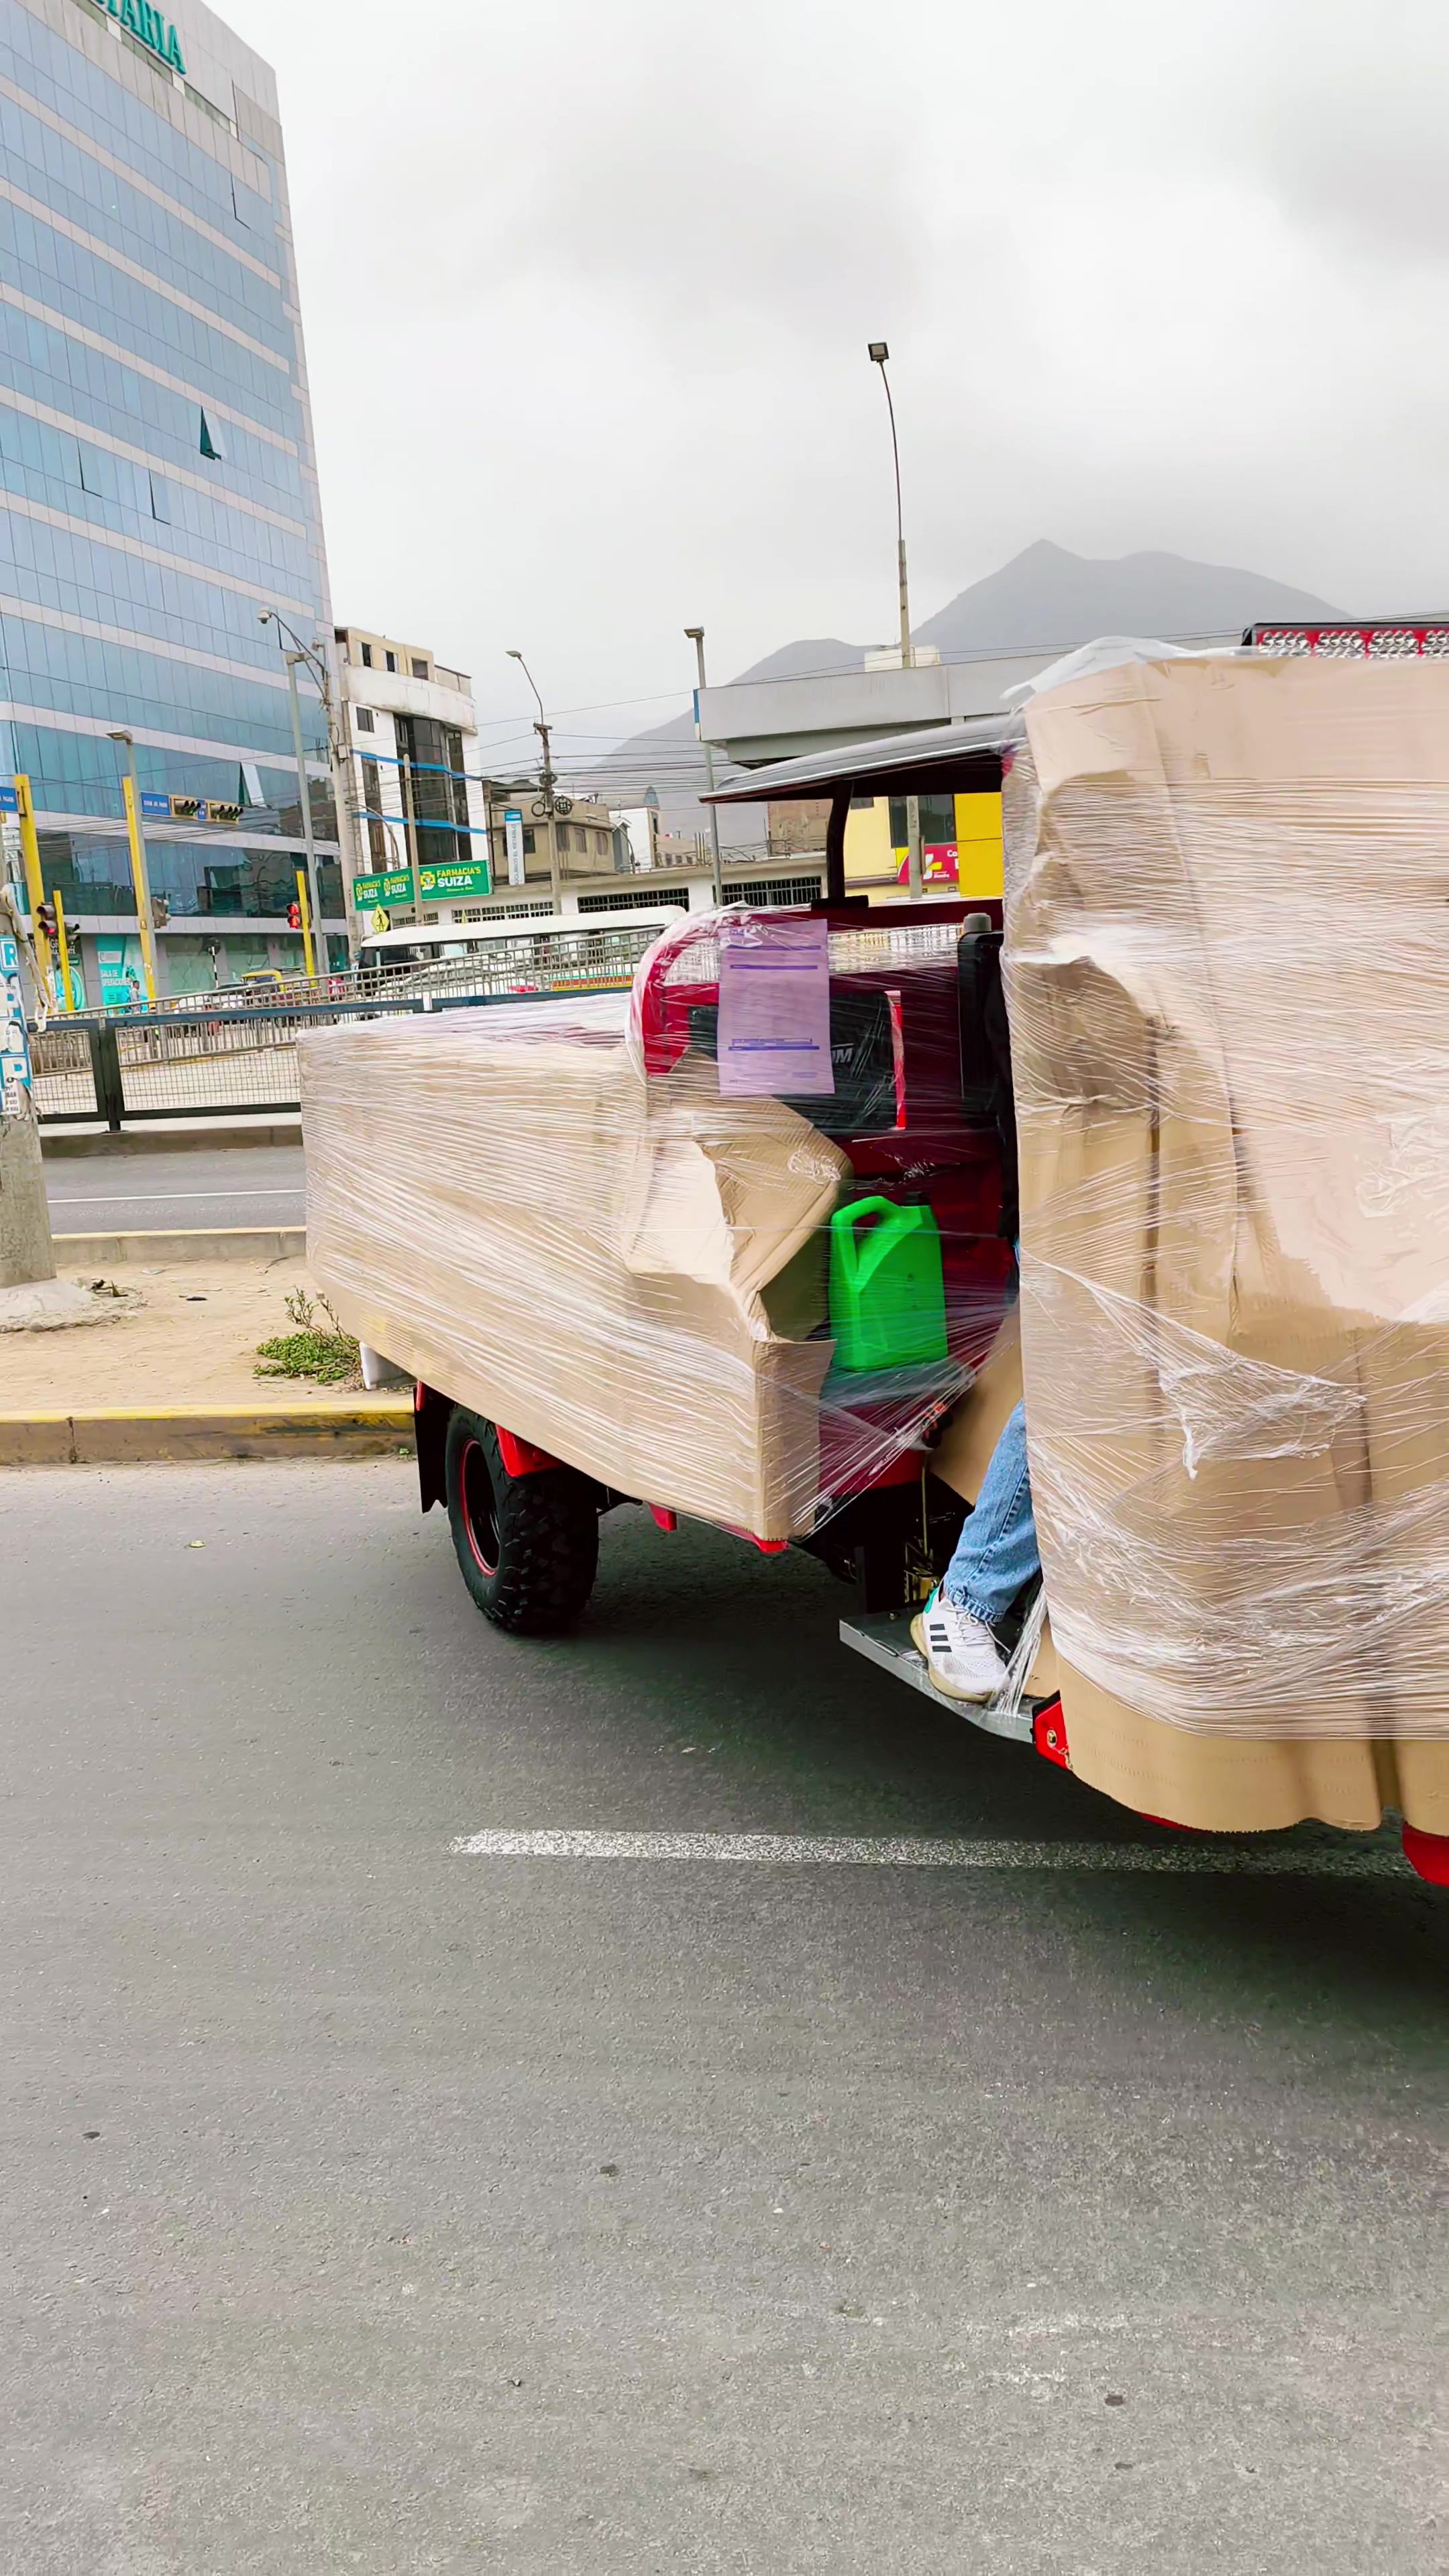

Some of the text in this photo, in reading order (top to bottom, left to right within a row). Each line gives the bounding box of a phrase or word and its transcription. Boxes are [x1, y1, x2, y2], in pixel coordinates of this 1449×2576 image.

[437, 867, 481, 877] FARMACIA'S
[437, 875, 473, 888] SUIZA
[363, 888, 378, 900] SUIZA
[391, 882, 407, 894] SUIZA
